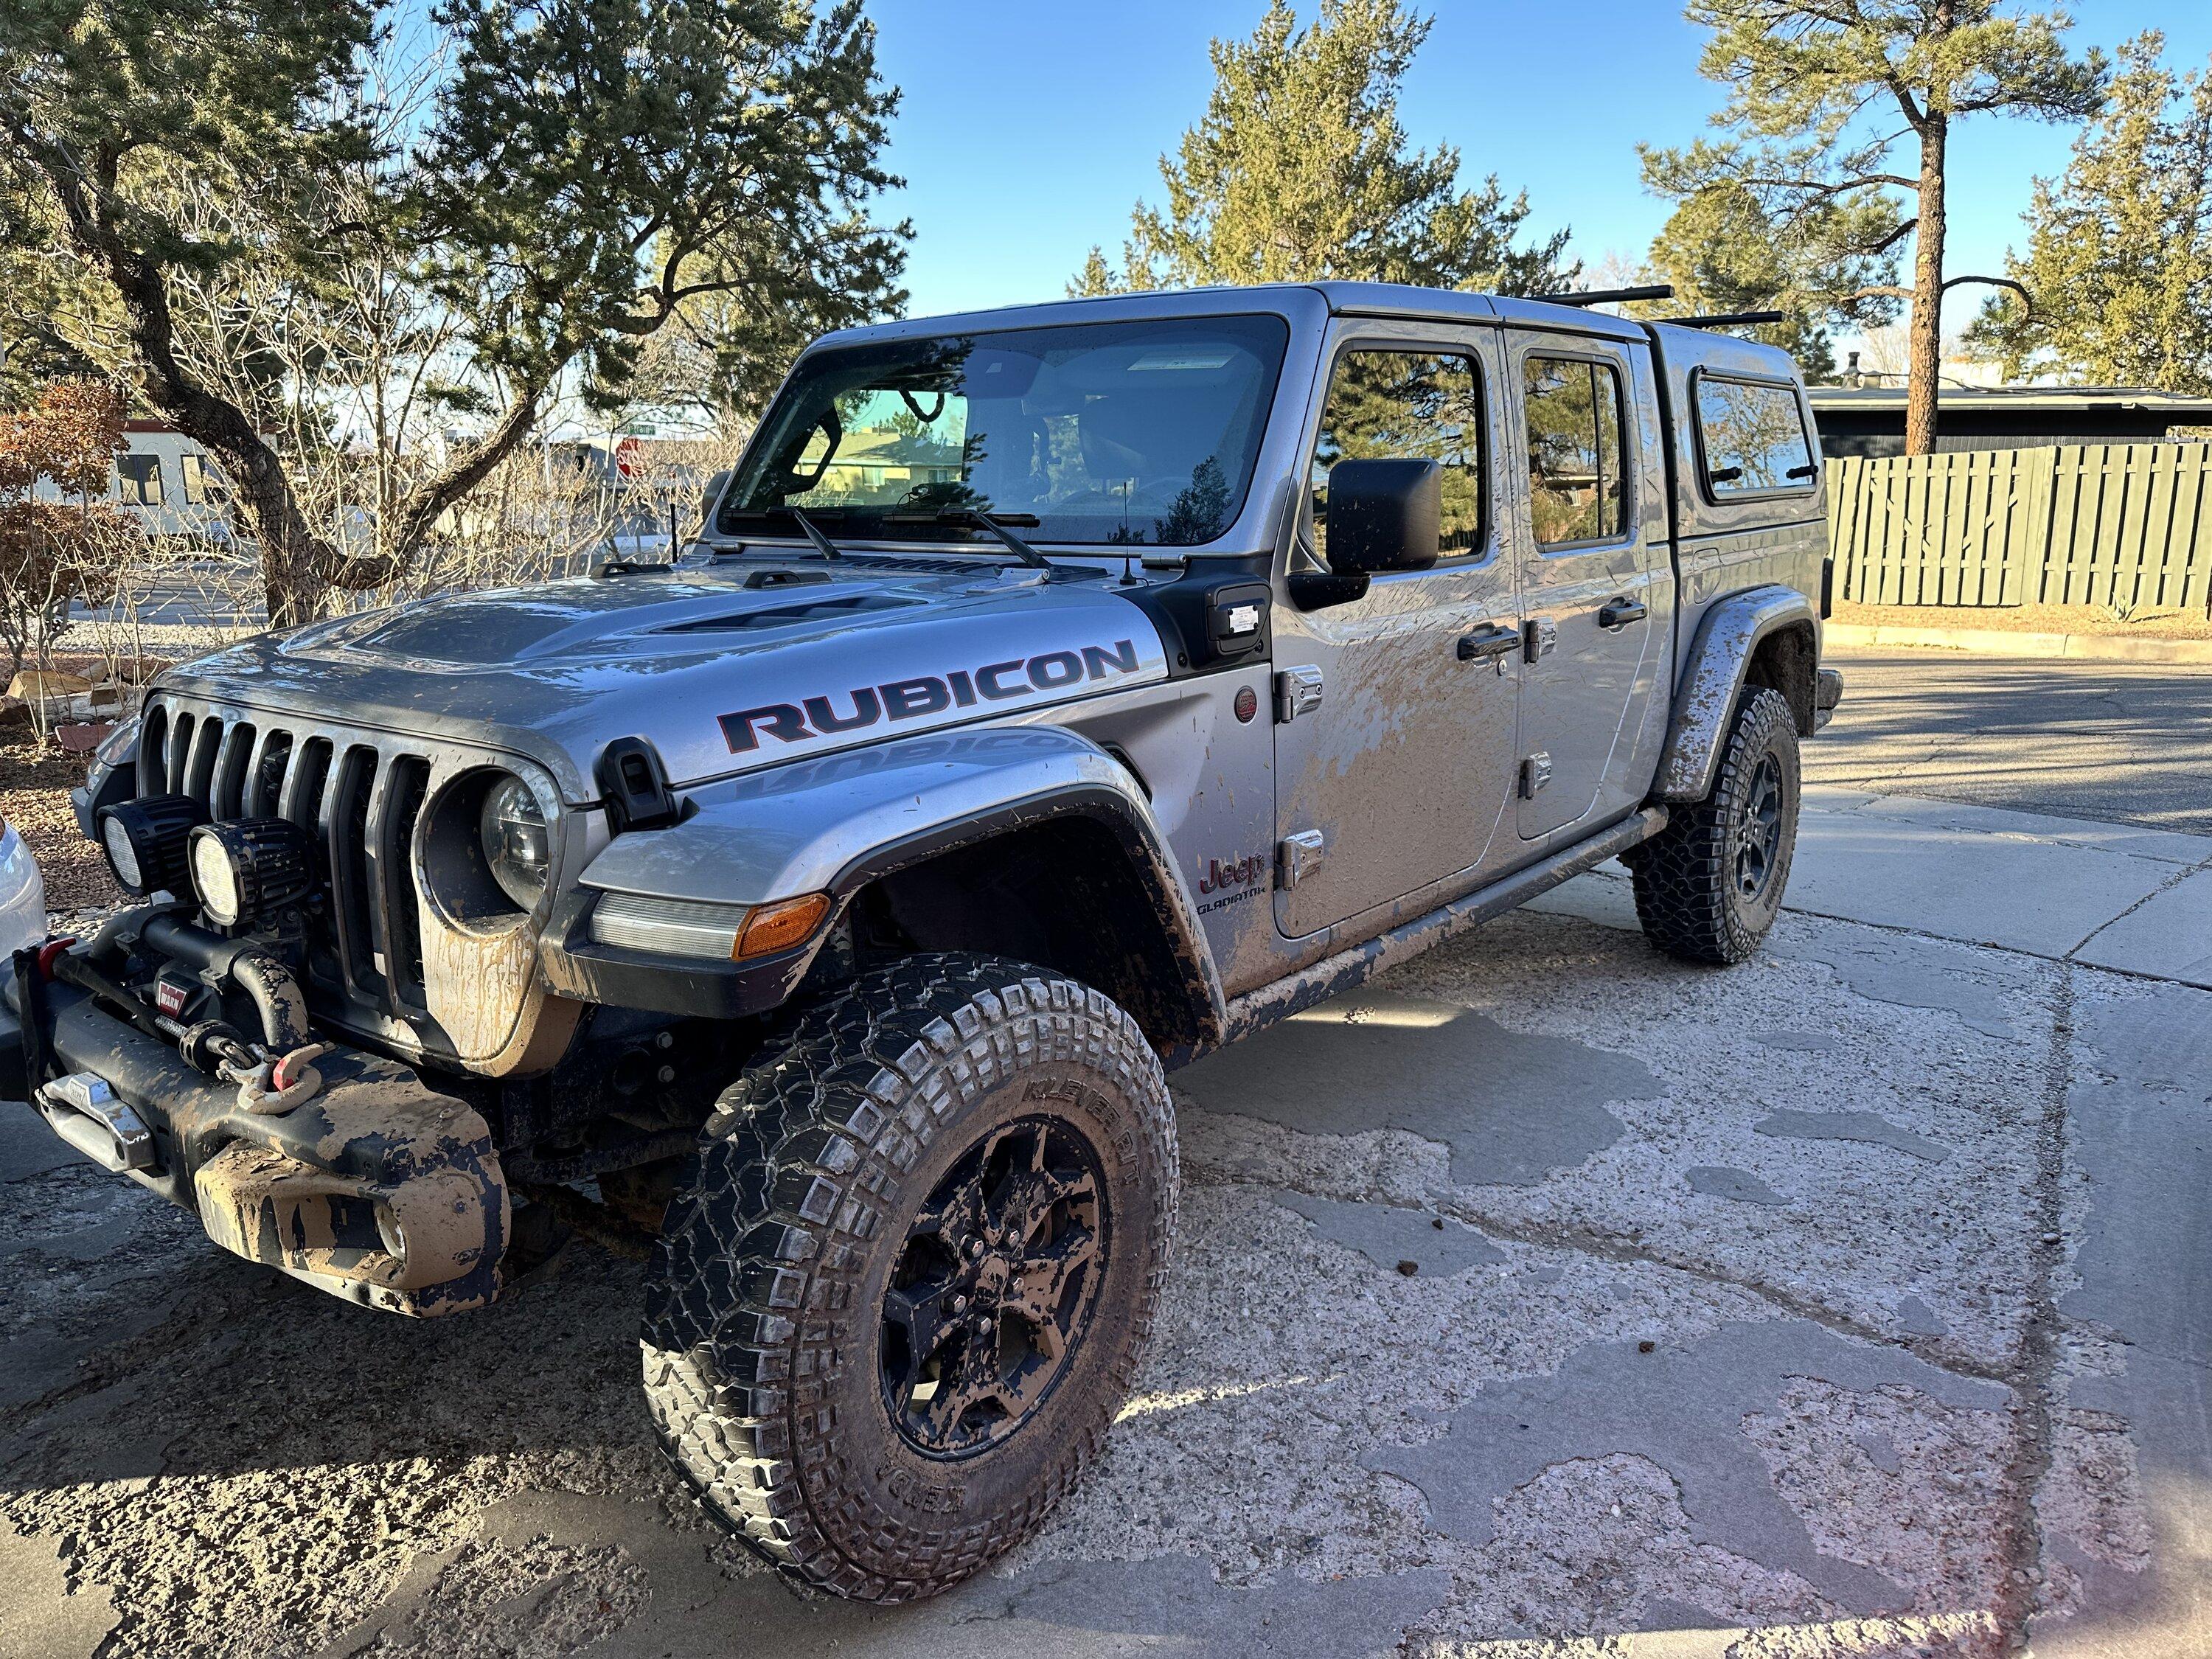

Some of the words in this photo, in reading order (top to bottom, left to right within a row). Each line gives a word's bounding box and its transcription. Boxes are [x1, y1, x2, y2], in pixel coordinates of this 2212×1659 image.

[716, 639, 1140, 754] RUBICON
[1200, 853, 1265, 894] Jeep
[161, 992, 179, 1010] WARN
